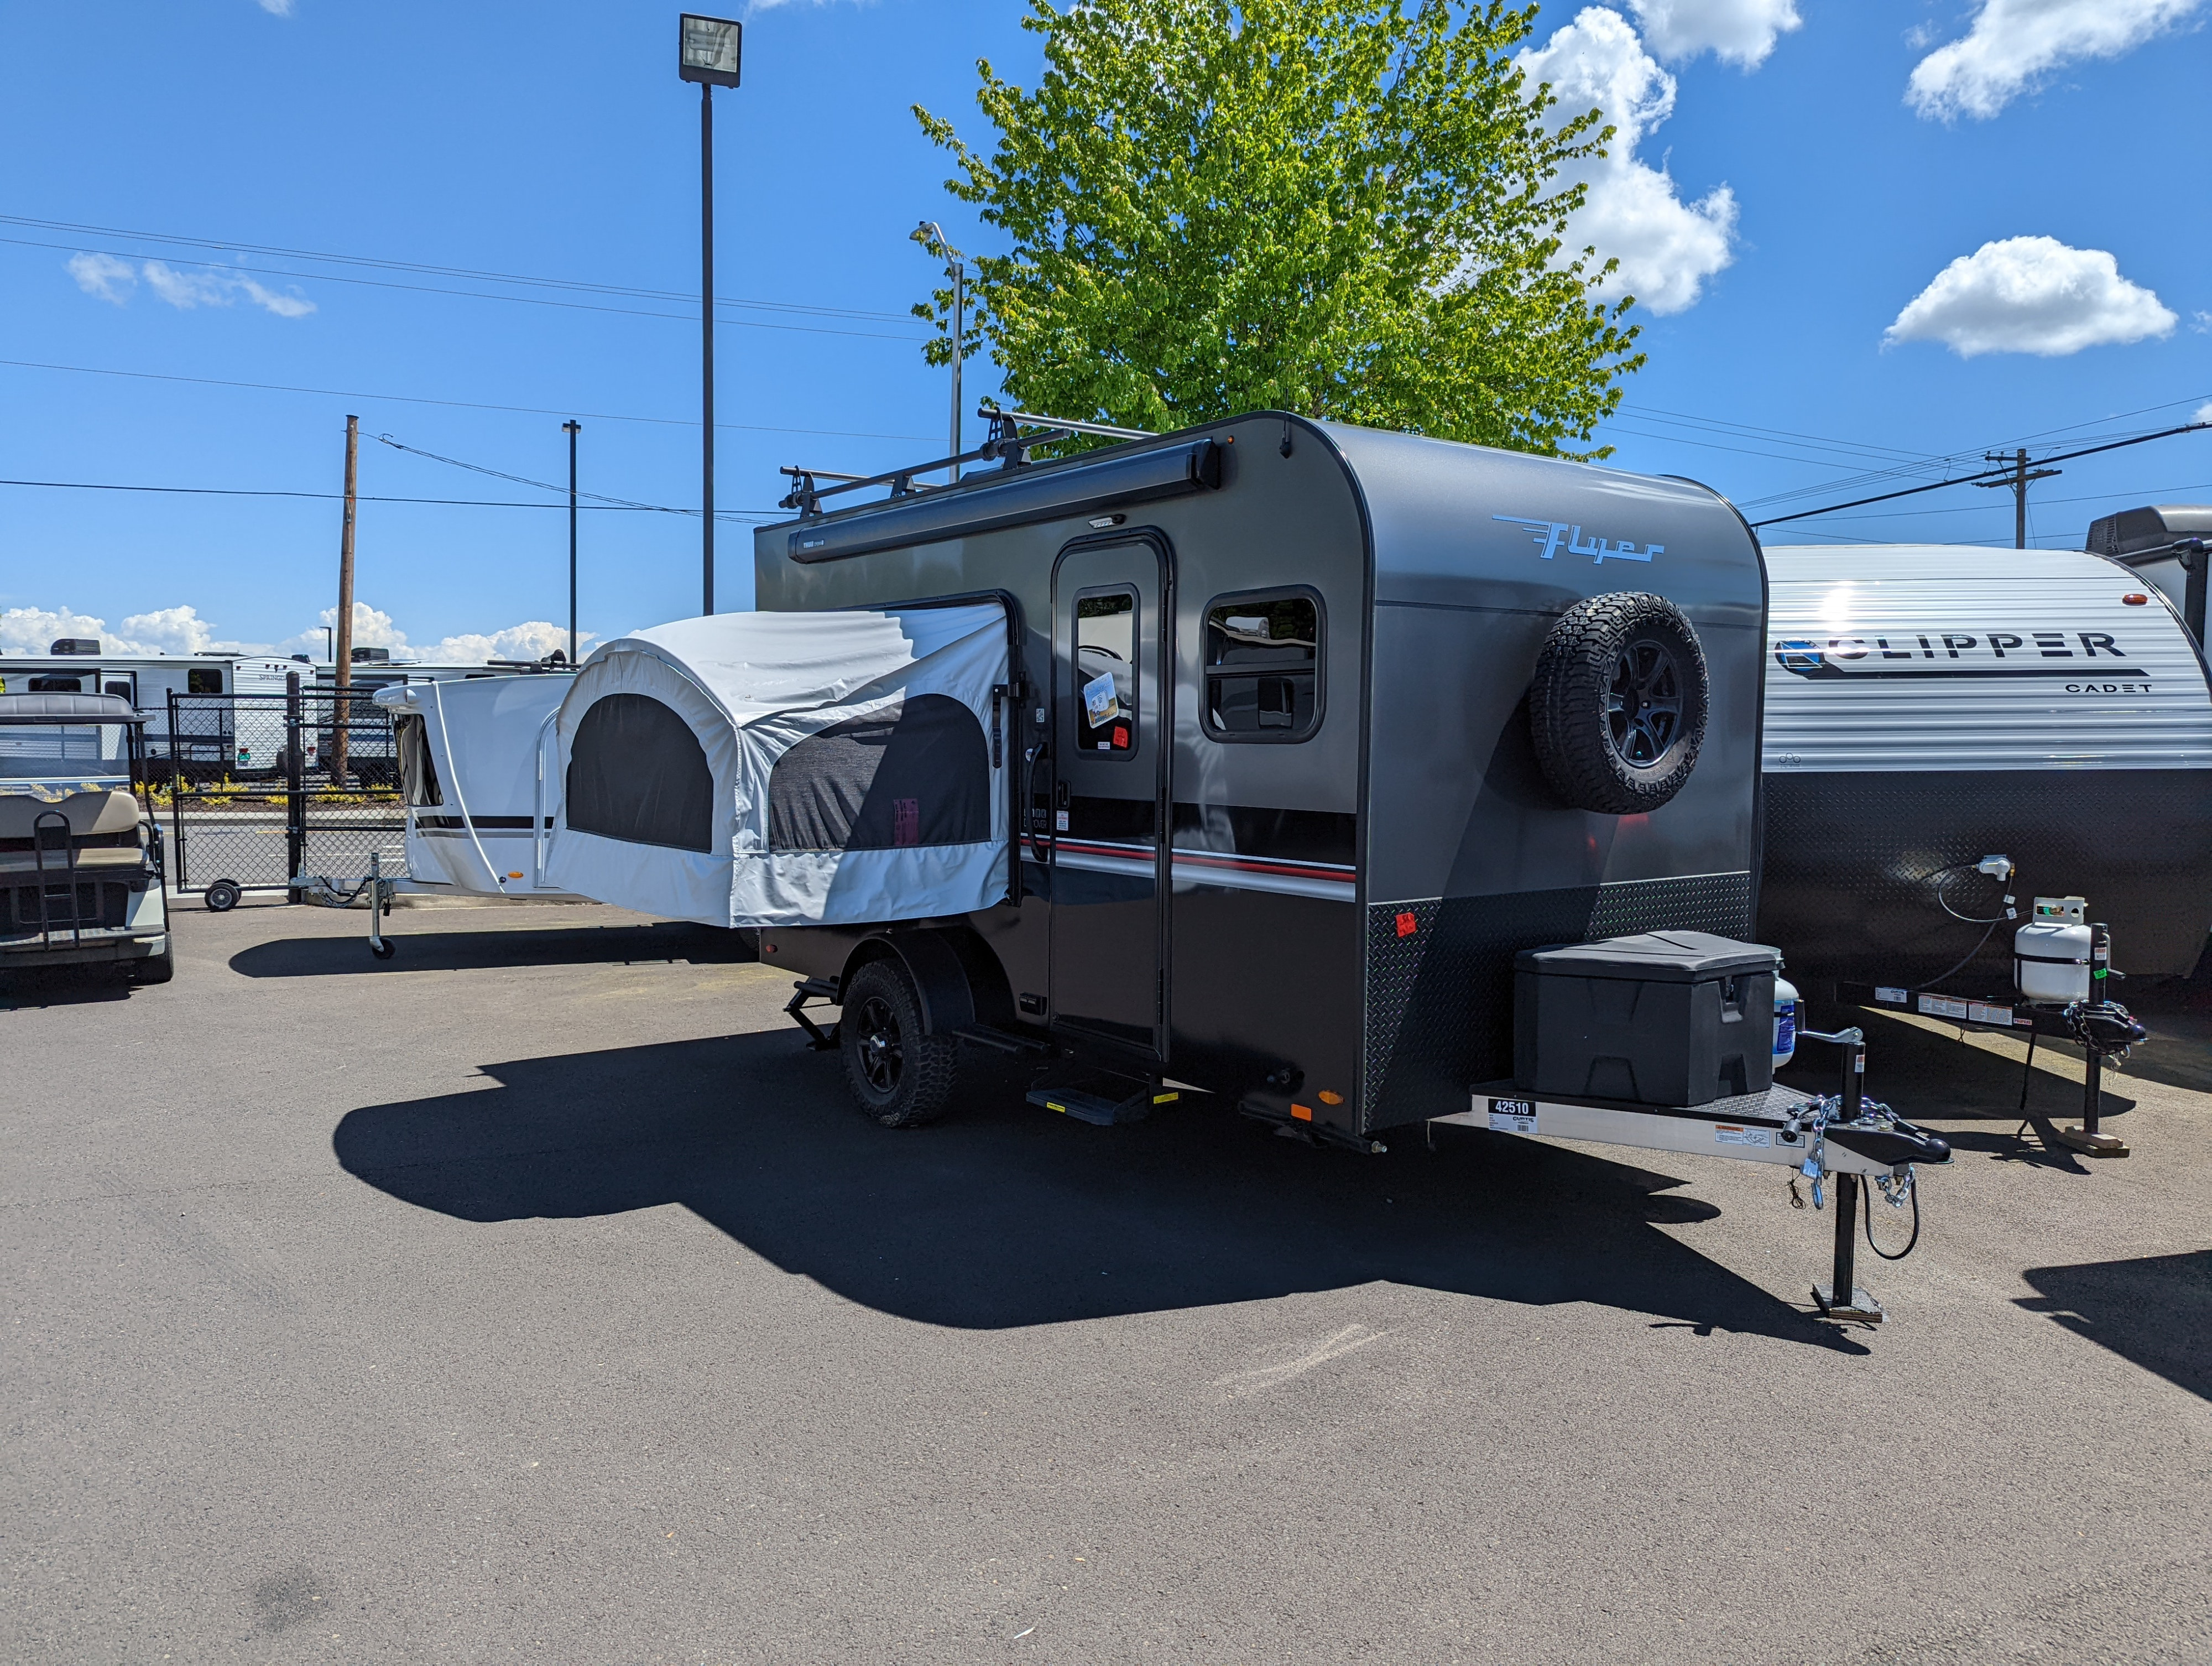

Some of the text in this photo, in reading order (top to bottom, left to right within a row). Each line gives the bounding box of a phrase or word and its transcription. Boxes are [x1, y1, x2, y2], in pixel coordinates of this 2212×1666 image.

[1492, 514, 1665, 565] Flyer
[1828, 633, 2127, 659] CLIPPER
[2065, 684, 2152, 693] CADET
[1495, 1101, 1528, 1114] 42510
